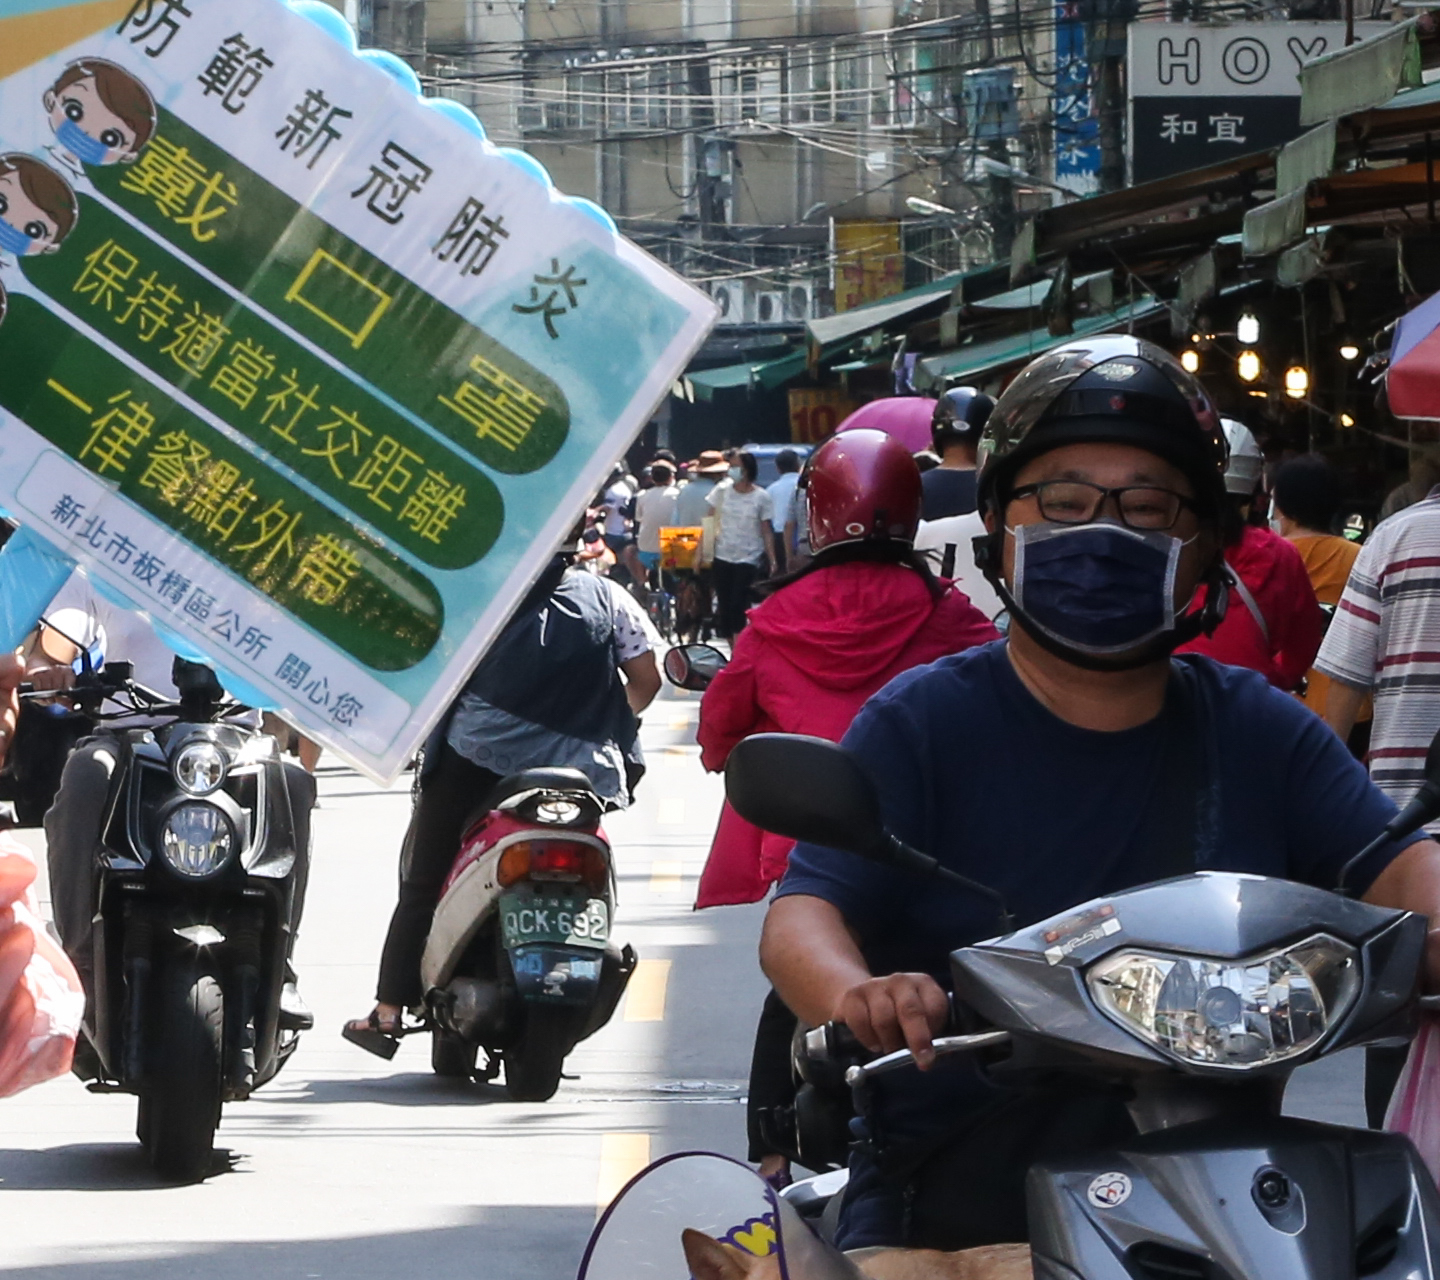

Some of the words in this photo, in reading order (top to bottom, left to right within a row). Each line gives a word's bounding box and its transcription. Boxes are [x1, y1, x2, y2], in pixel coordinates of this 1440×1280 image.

[1160, 113, 1247, 144] 和宜
[70, 239, 468, 545] 保持適當社交距離
[119, 131, 547, 450] 戴口罩
[46, 376, 363, 606] 一律餐點外帶
[50, 493, 273, 662] 新北市板橋區公所
[274, 652, 365, 728] 關心您
